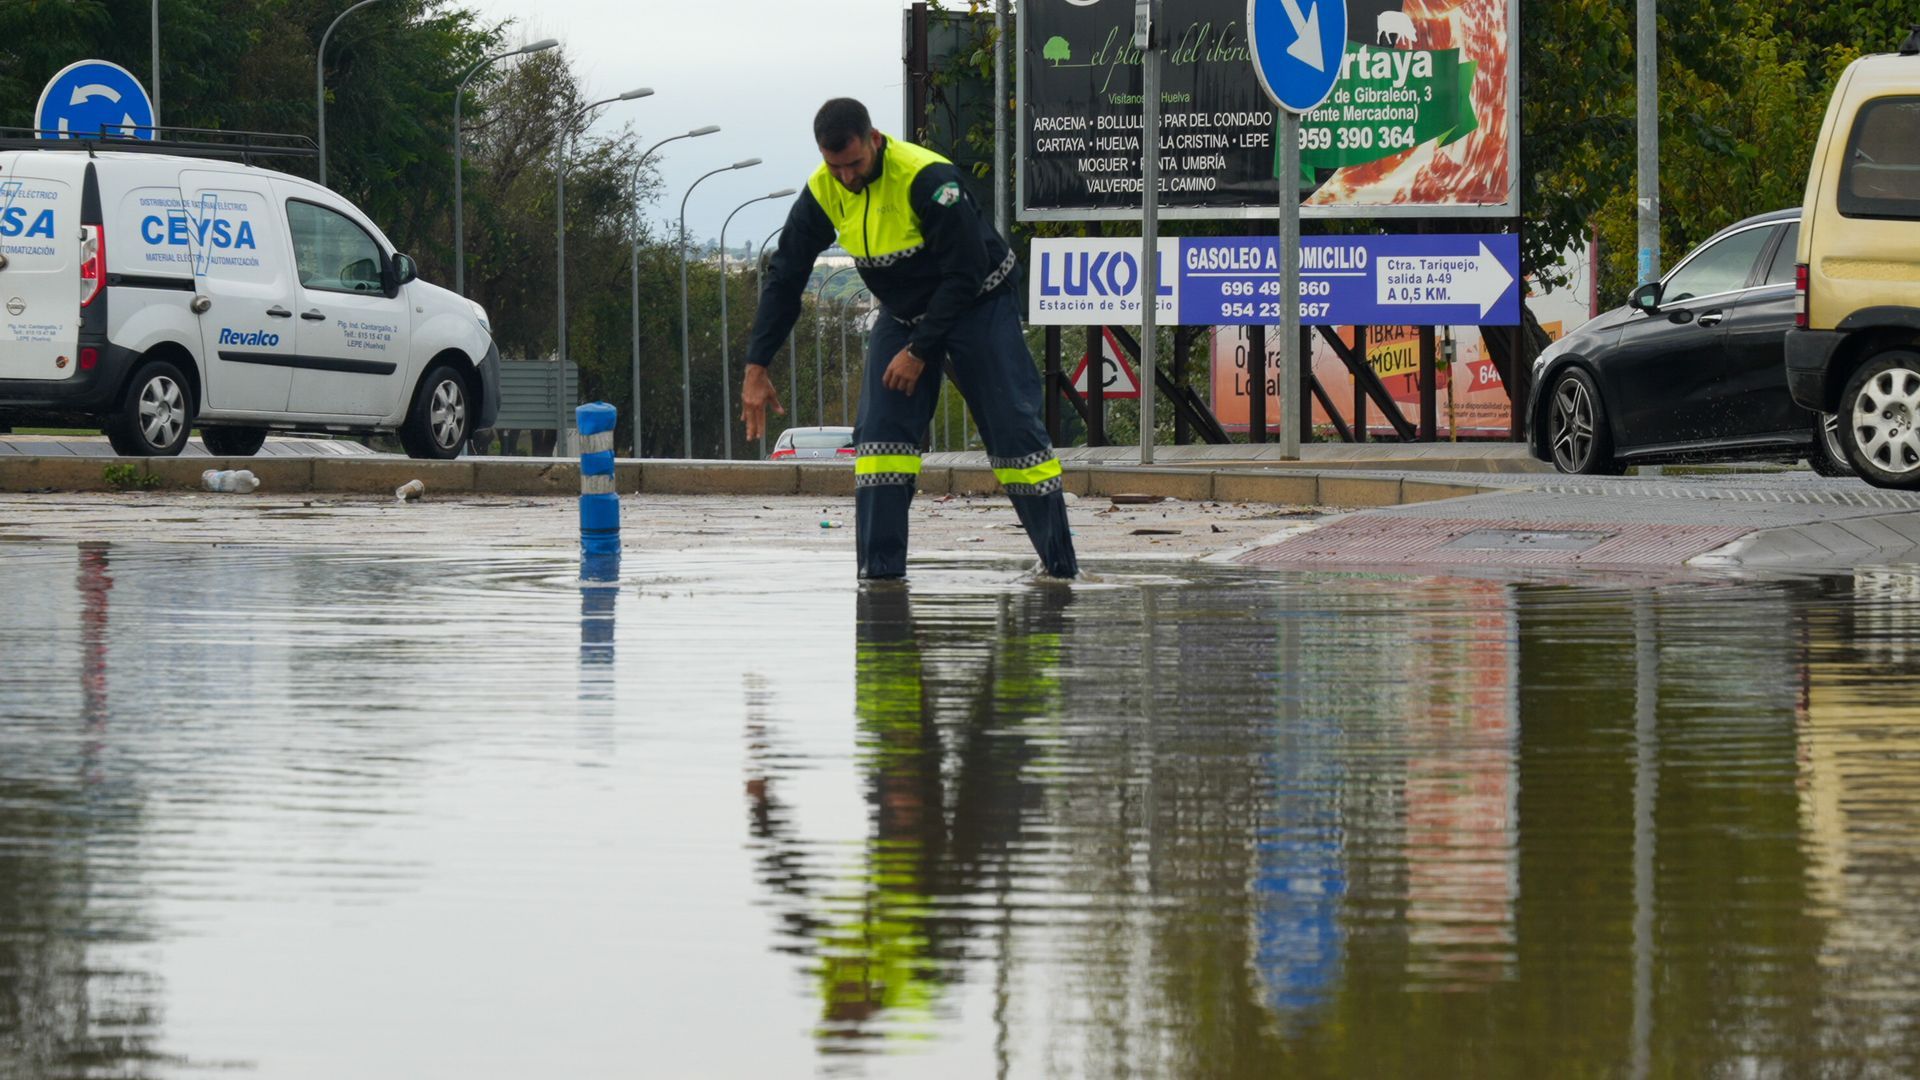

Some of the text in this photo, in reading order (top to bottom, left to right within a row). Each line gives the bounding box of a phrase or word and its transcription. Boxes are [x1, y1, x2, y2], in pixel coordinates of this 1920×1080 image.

[1091, 25, 1118, 66] el
[1171, 22, 1211, 66] del
[1337, 44, 1433, 88] rtaya
[1161, 92, 1191, 103] Huelva
[1334, 88, 1350, 103] de
[1355, 86, 1421, 104] Gibraleón,
[1424, 86, 1432, 101] 3
[1034, 116, 1087, 131] ARACENA
[1164, 113, 1187, 127] PAR
[1189, 113, 1212, 127] DEL
[1213, 111, 1272, 126] CONDADO
[1343, 104, 1419, 123] Mercadona)
[1036, 137, 1086, 152] CARTAYA
[1096, 136, 1139, 151] HUELVA
[1176, 134, 1229, 149] CRISTINA
[1240, 133, 1269, 148] LEPE
[1298, 125, 1415, 150] 959 390 364
[1078, 157, 1129, 172] MOGUER
[1182, 153, 1226, 170] UMBRÍA
[1086, 178, 1144, 193] VALVERDE
[1170, 177, 1216, 192] CAMINO
[0, 207, 55, 239] SA
[141, 215, 256, 250] CEYSA
[1187, 247, 1261, 270] GASOLEO
[1265, 247, 1277, 269] A
[1388, 259, 1479, 273] Ctra. Tariquejo,
[1221, 281, 1330, 296] 696 49 860
[1387, 273, 1452, 285] salida A-49
[1387, 287, 1451, 303] A 0,5 KM.
[1039, 299, 1173, 311] Estación de Sercio
[1221, 302, 1330, 317] 954 23 667
[218, 327, 279, 347] Revalco
[1371, 347, 1417, 373] MÓVIL
